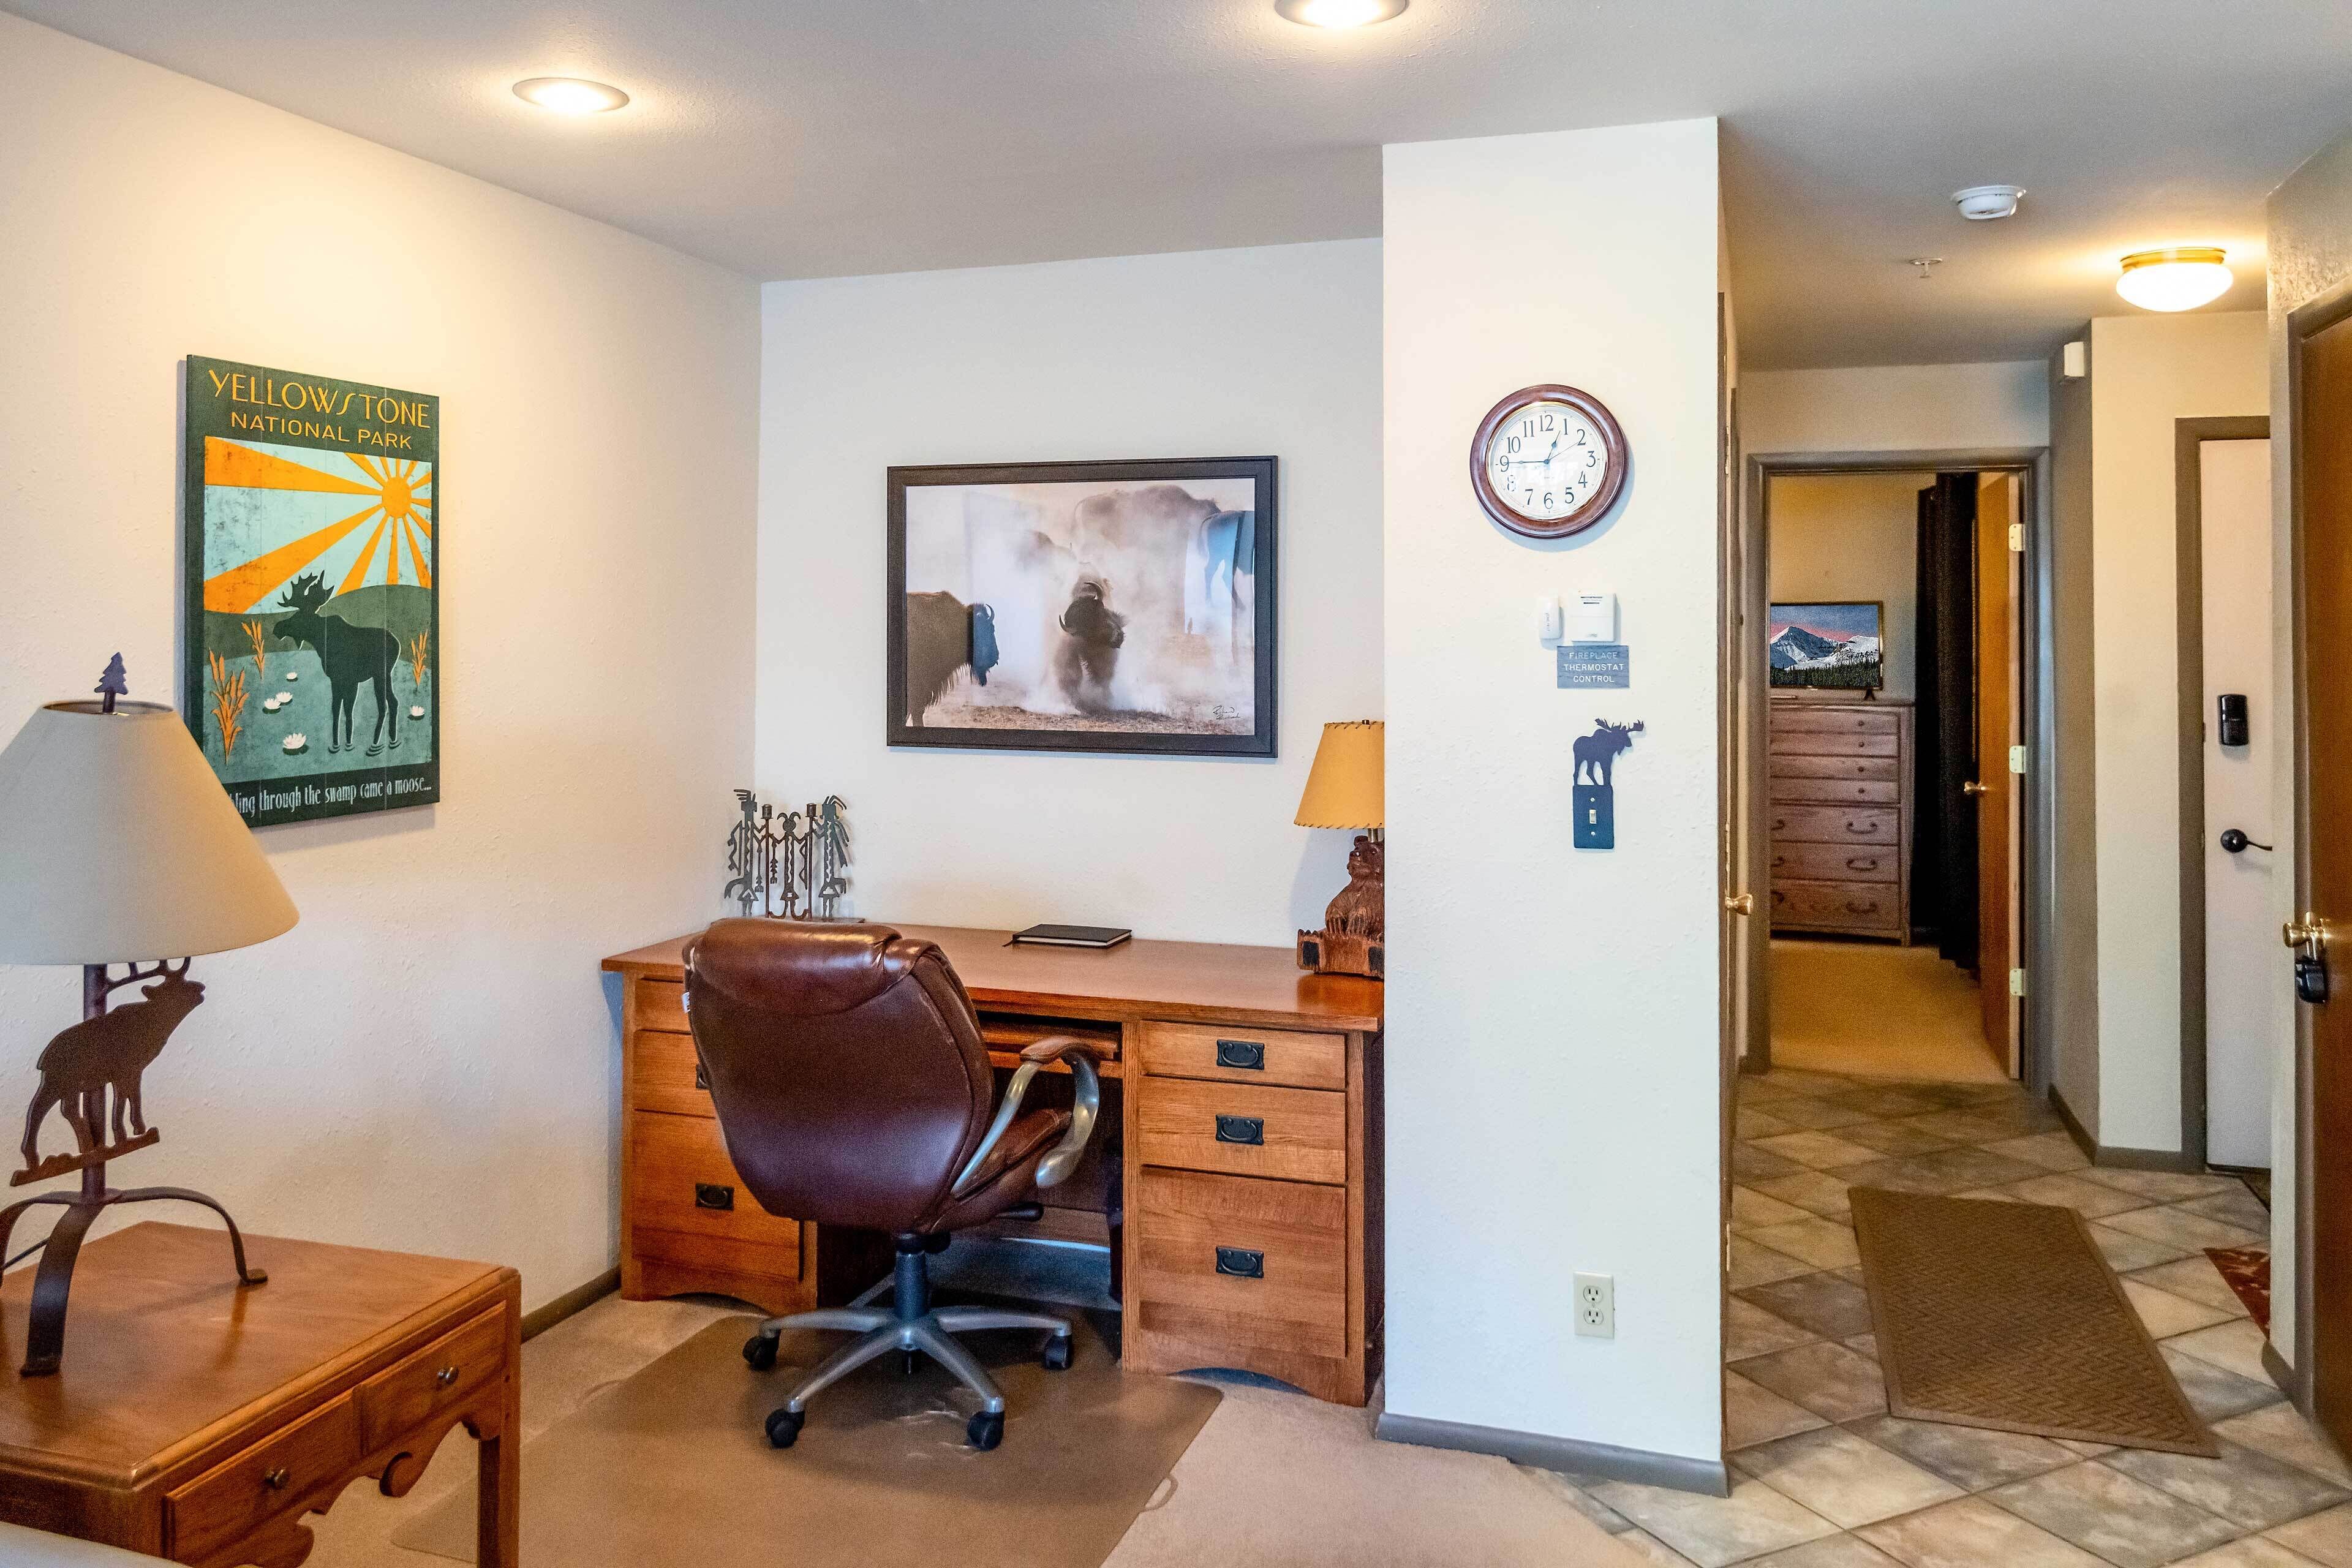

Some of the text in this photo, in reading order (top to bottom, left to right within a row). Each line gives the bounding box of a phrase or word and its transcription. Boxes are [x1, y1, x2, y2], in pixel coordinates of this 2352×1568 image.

[208, 369, 430, 429] YELLOWSTONE
[232, 412, 412, 450] NATIONAL PARK
[1523, 420, 1534, 437] 11
[1539, 415, 1554, 432] 12
[1563, 418, 1568, 435] 1
[1506, 436, 1521, 453] 10
[1577, 429, 1586, 446] 2
[1500, 456, 1510, 472] 9
[1586, 451, 1596, 467] 3
[1578, 471, 1588, 488] 4
[1525, 489, 1534, 505] 7
[1544, 492, 1553, 509] 6
[1565, 487, 1574, 503] 5
[230, 777, 432, 818] ling through the swamp came a moose...
